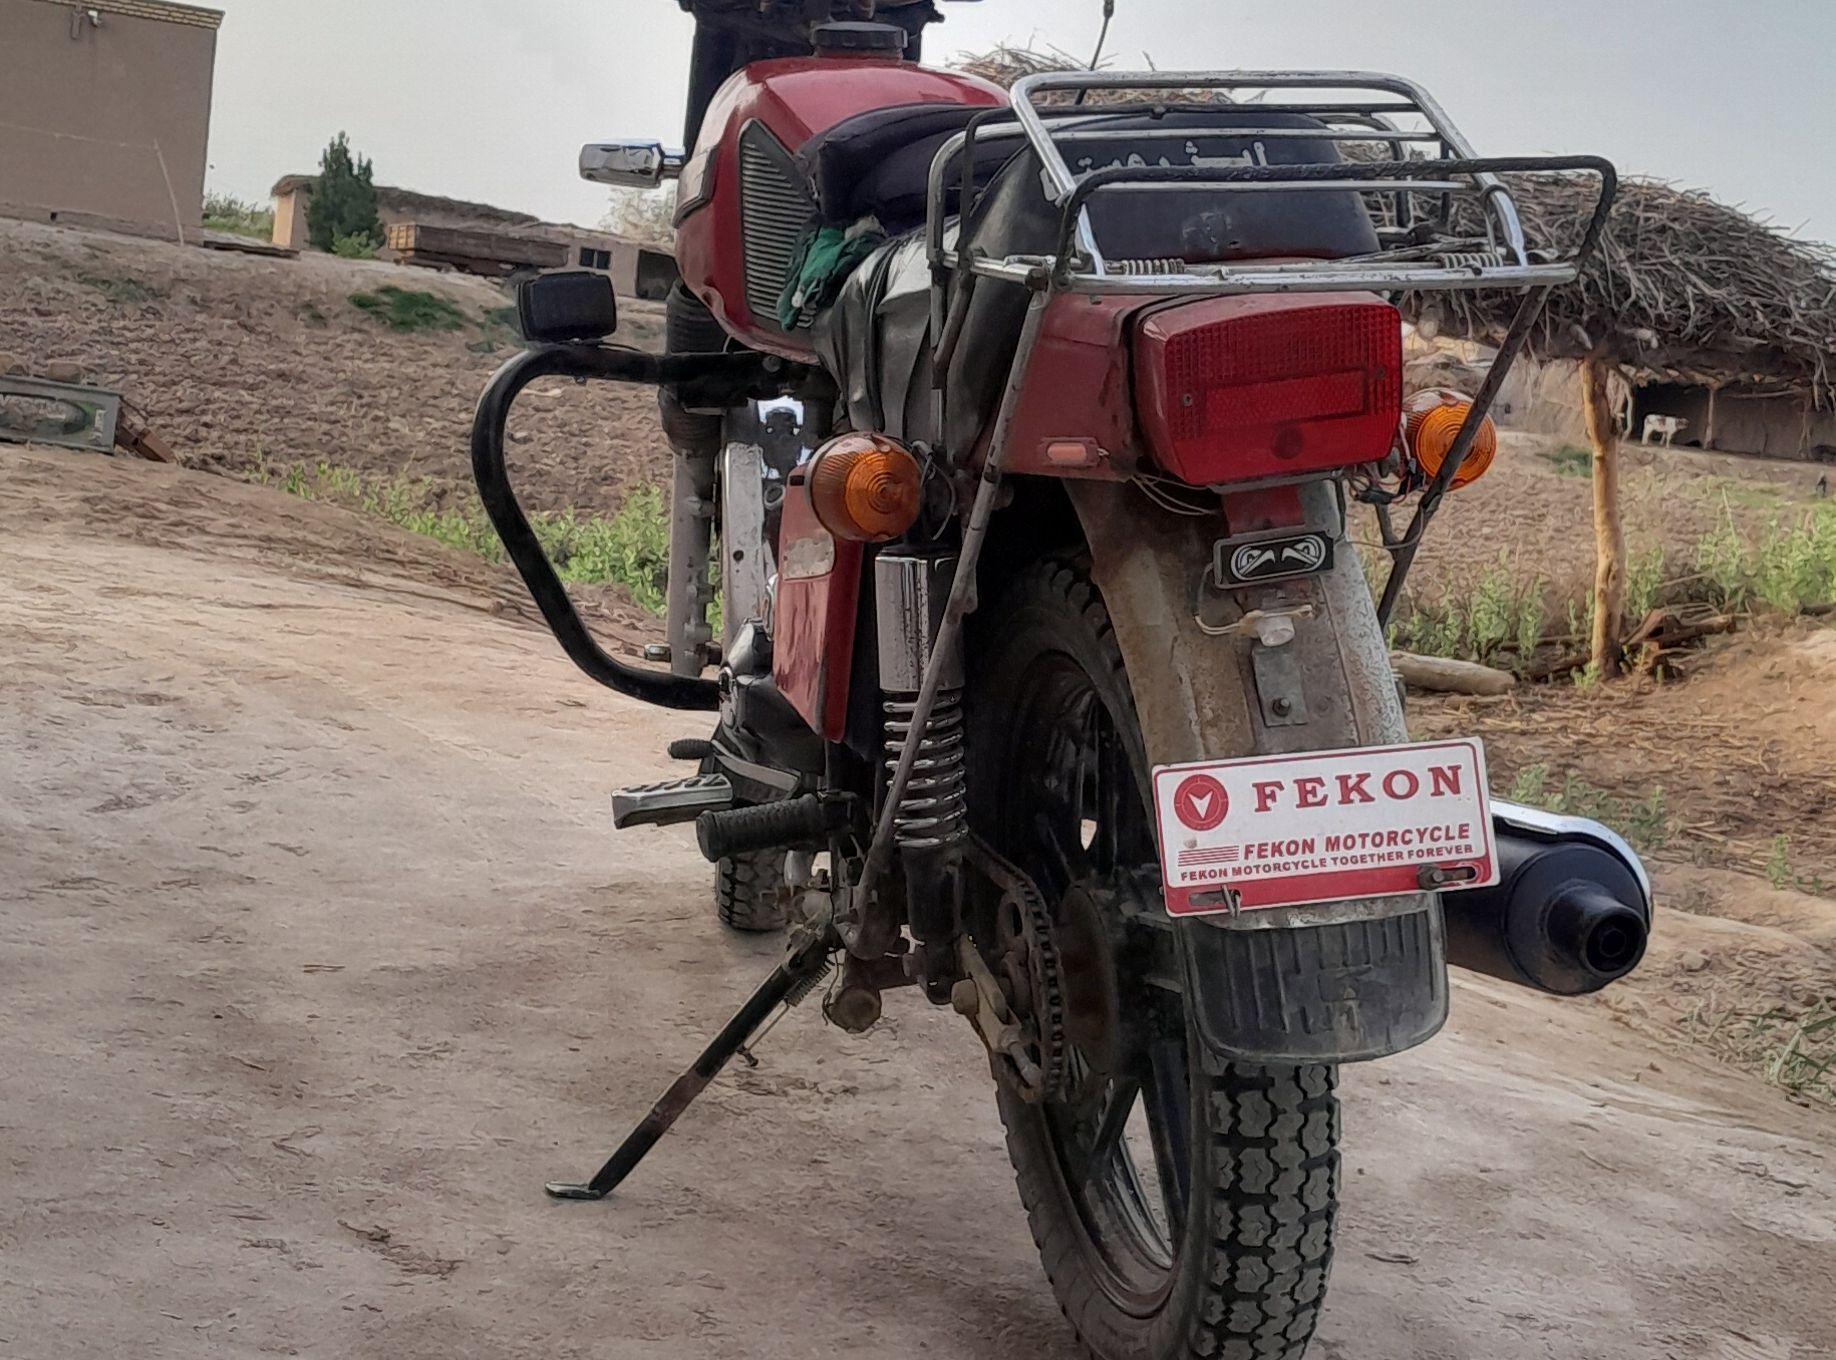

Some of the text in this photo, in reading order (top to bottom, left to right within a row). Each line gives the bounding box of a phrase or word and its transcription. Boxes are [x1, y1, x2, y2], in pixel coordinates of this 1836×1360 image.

[1252, 765, 1463, 813] FEKON
[1244, 823, 1470, 861] FEKON MOTORCYCLE
[1181, 844, 1473, 881] FEKON MOTORCYCLE TOGETHER FOREVER
